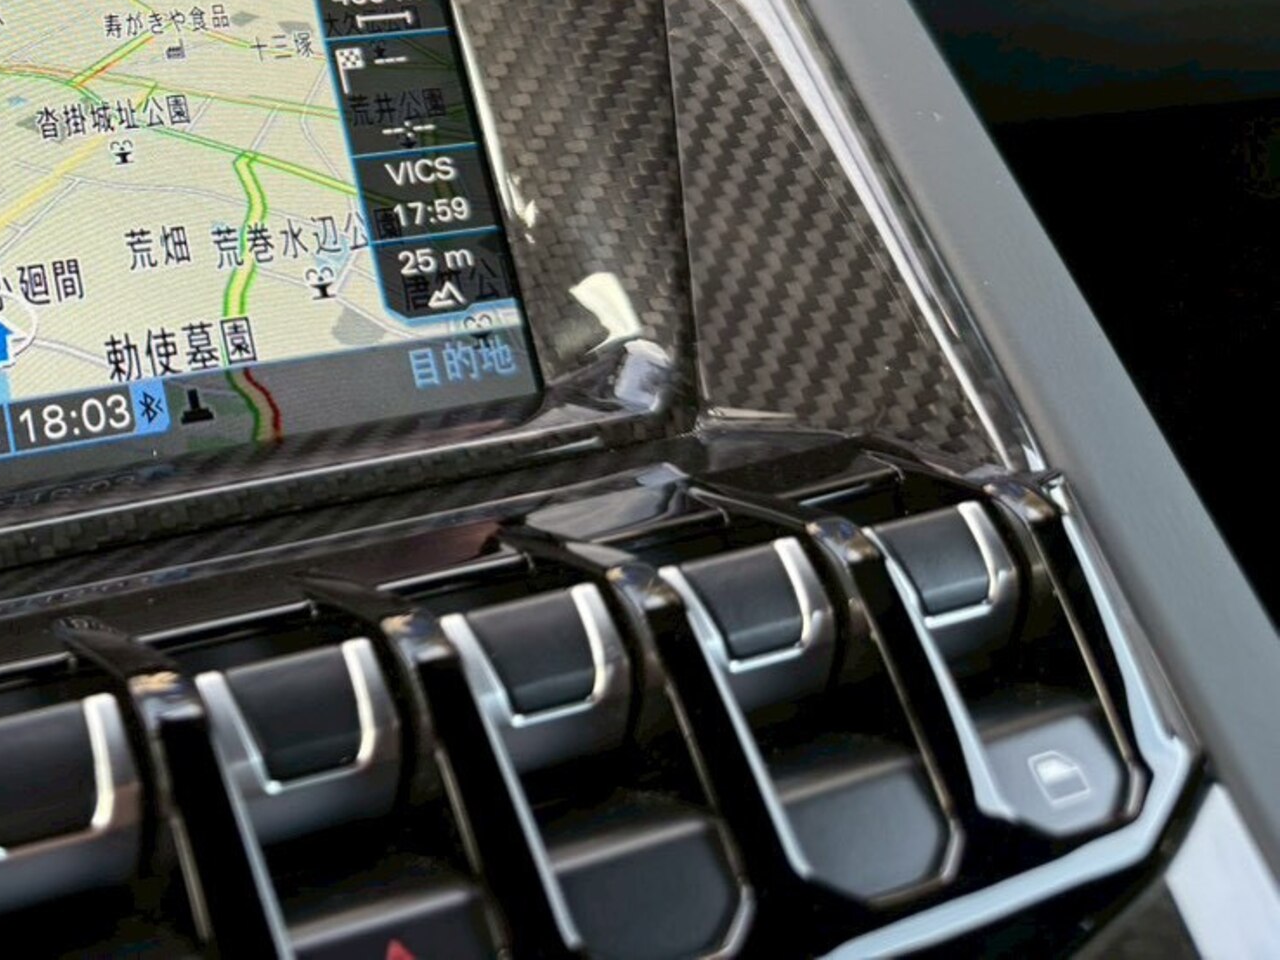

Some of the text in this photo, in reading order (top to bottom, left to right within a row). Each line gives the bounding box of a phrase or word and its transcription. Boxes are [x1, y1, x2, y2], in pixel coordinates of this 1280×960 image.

[104, 4, 230, 38] 寿がきや食品
[249, 31, 314, 61] 十三塚
[384, 157, 457, 187] VICS
[393, 196, 470, 228] 17:59
[124, 225, 191, 271] 荒畑
[398, 248, 475, 276] 25 m
[105, 316, 258, 384] 勅使墓園
[408, 334, 516, 390] 目的地
[18, 394, 131, 444] 18:03
